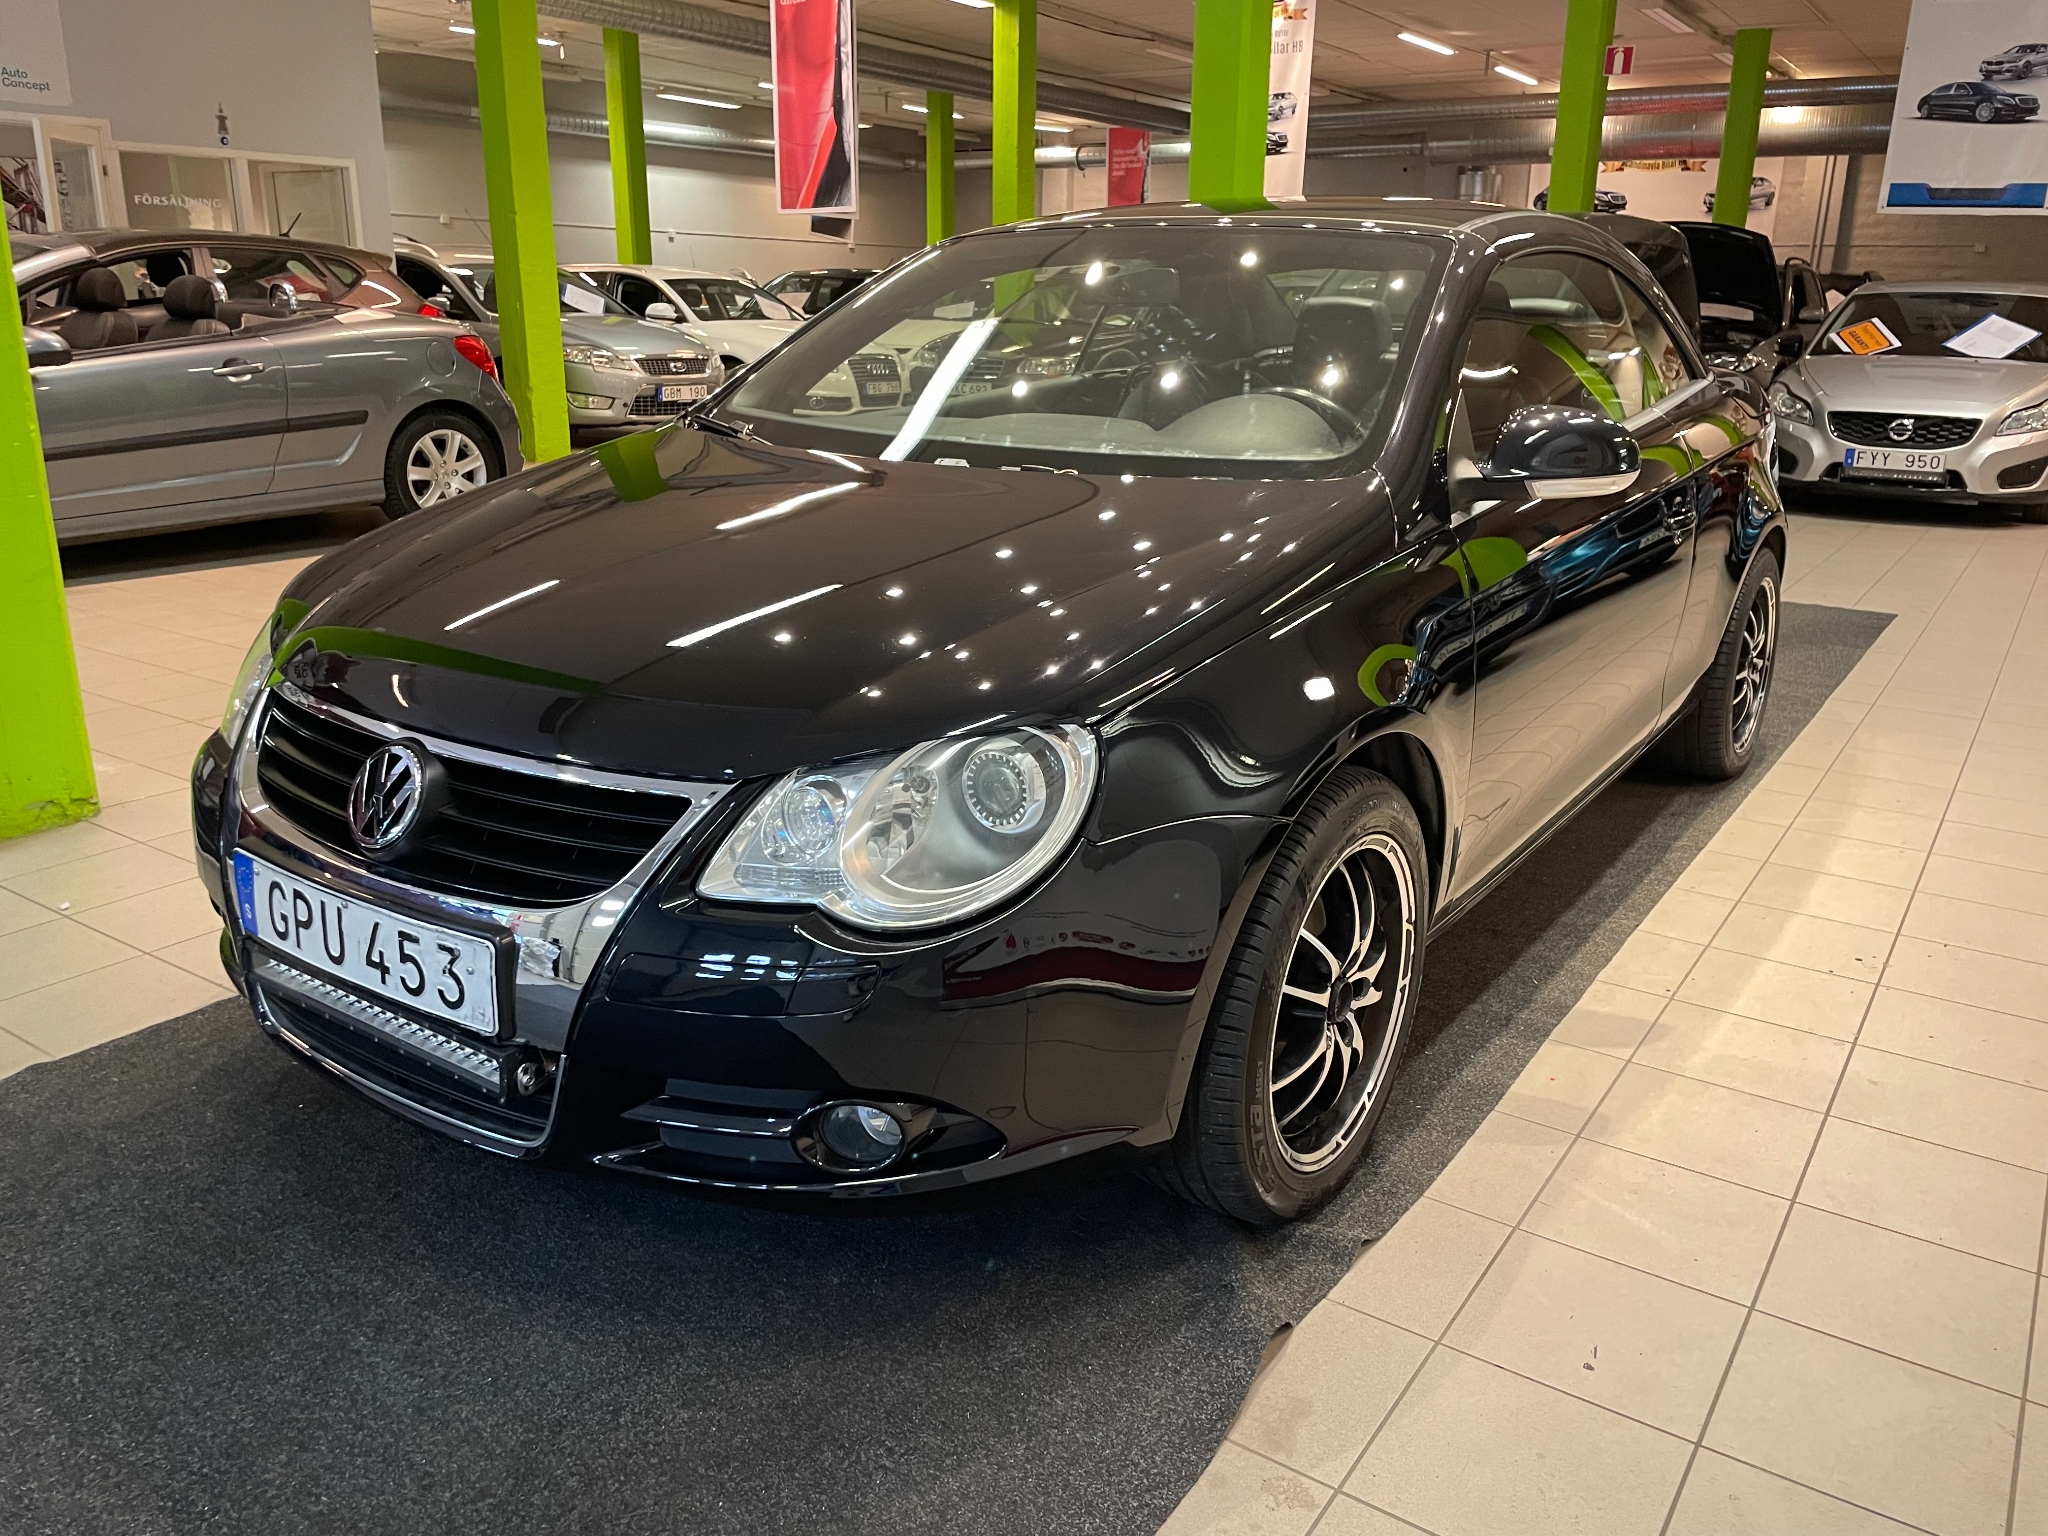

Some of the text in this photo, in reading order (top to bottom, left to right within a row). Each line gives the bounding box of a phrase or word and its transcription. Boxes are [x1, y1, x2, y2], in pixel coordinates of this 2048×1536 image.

[1273, 40, 1304, 55] ilar HB
[1, 66, 28, 79] Auto
[2, 77, 51, 93] Concept
[663, 386, 706, 399] GBM 190
[952, 384, 967, 394] KC
[1856, 451, 1941, 470] FYY 950
[268, 879, 466, 1010] GPU 453
